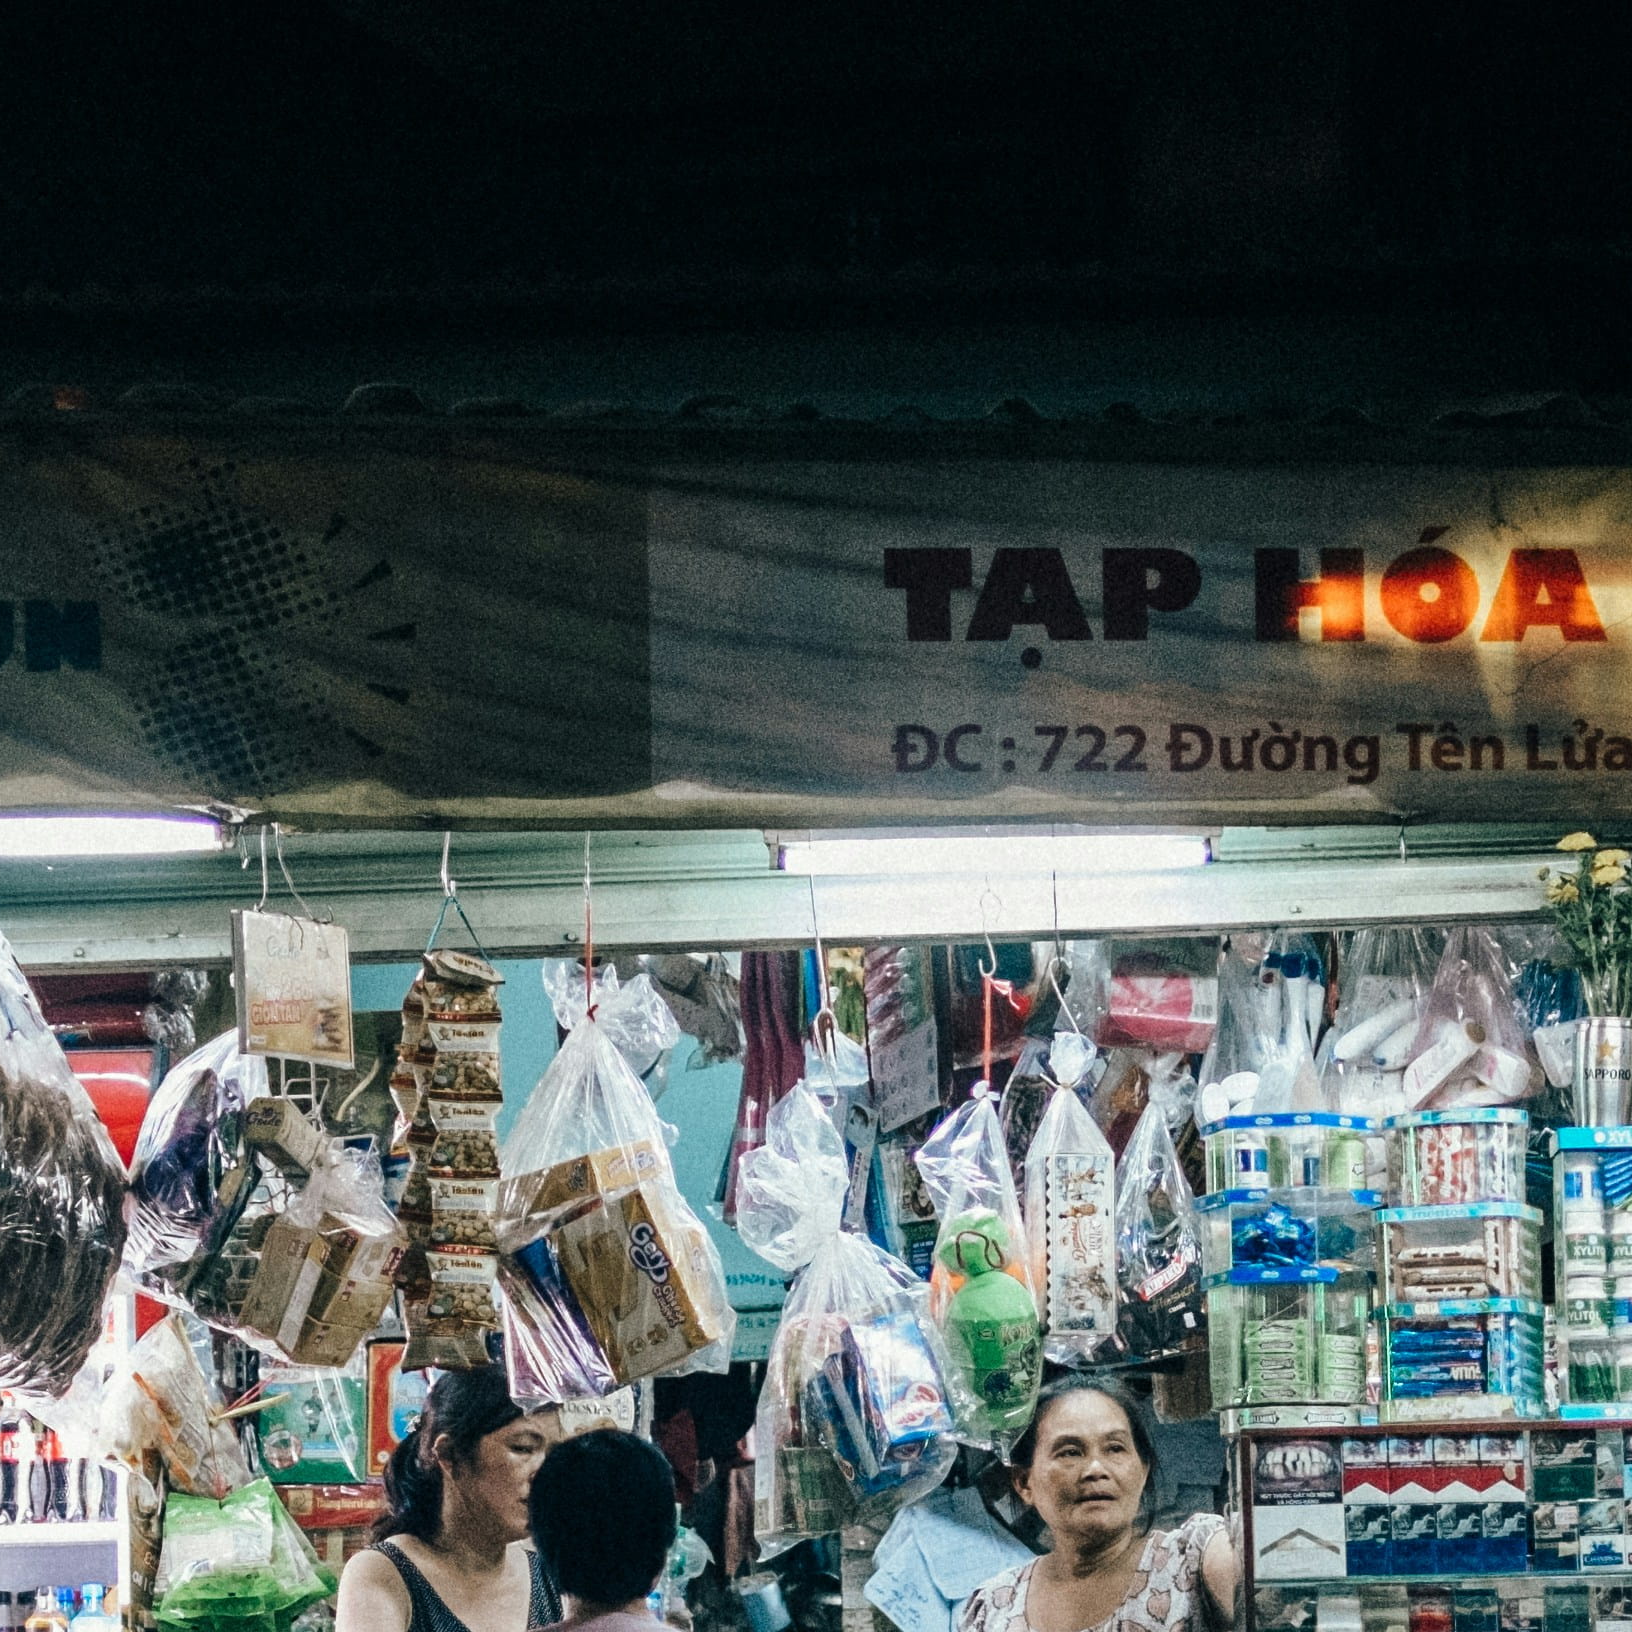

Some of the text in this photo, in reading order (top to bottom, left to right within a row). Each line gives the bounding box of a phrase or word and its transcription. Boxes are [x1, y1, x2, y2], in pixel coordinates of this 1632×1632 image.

[883, 546, 1203, 671] TẠP
[1252, 525, 1608, 645] HÓA
[1034, 723, 1149, 775] 722
[1164, 721, 1384, 787] Đường
[1406, 720, 1507, 774] Tên
[1583, 1066, 1632, 1082] SAPPORO
